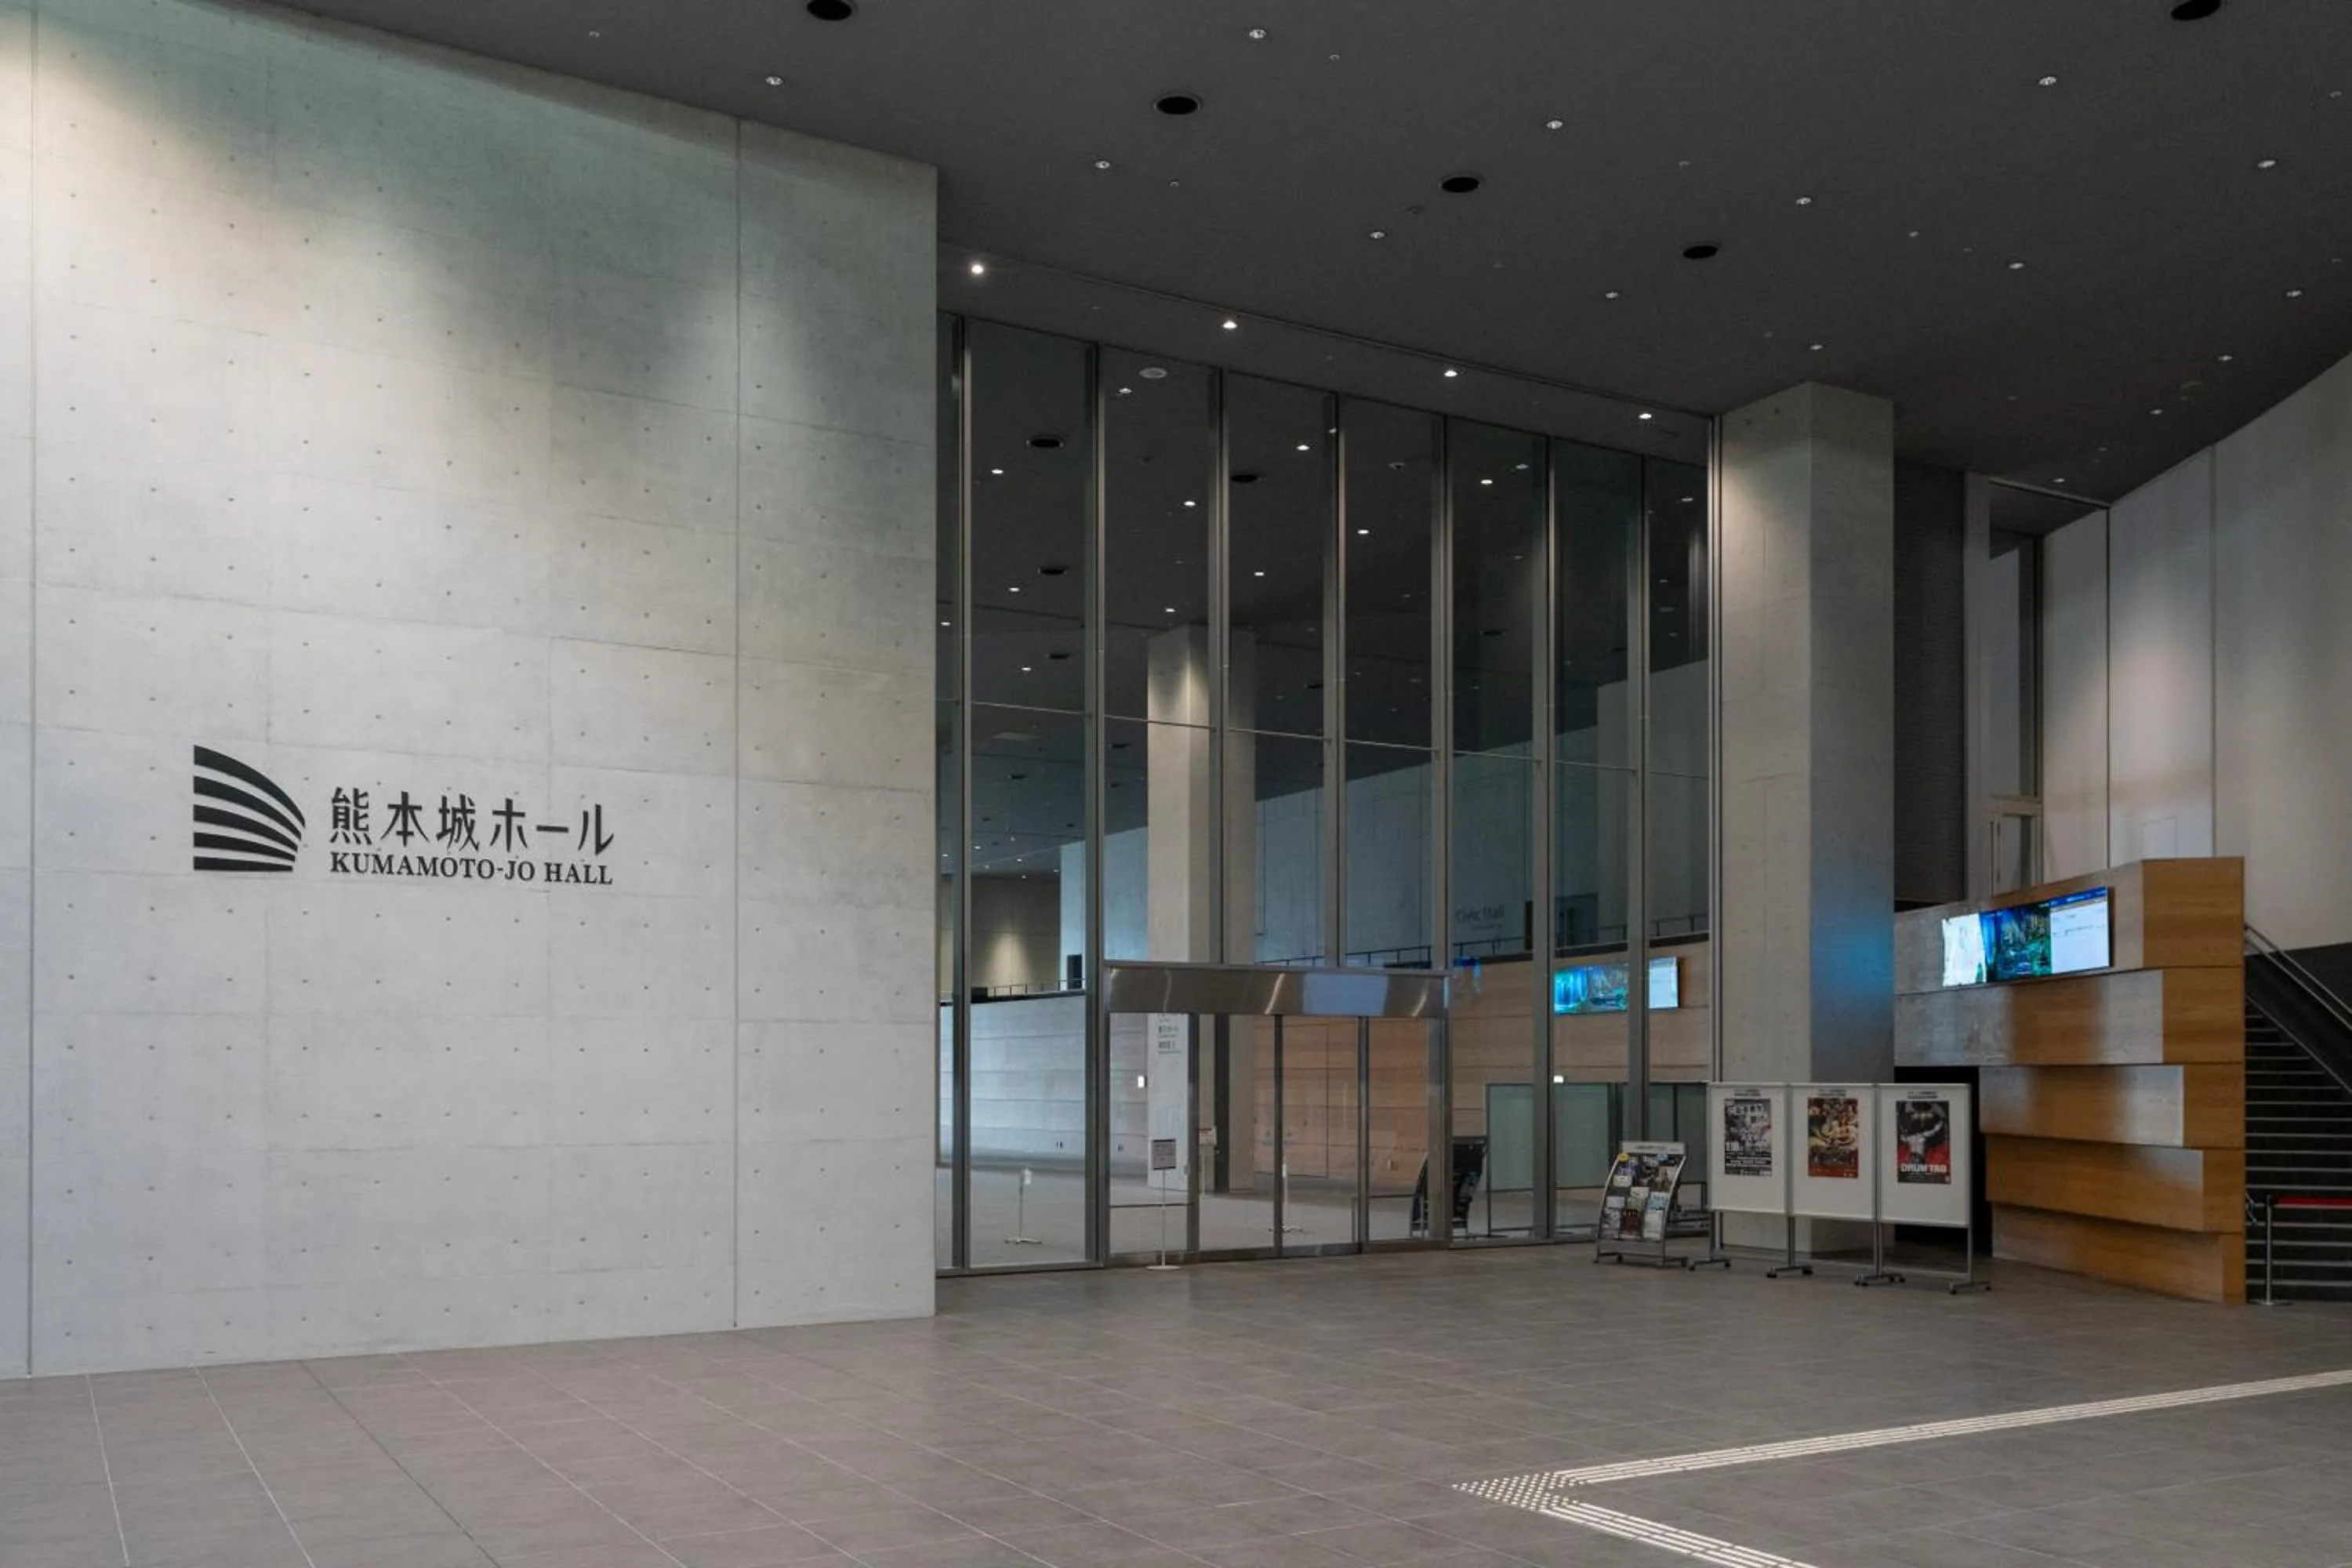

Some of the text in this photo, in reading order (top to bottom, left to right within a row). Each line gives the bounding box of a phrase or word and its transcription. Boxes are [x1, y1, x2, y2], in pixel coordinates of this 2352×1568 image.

[329, 786, 615, 855] 熊本城ホール
[330, 851, 614, 885] KUMAMOTO-JO HALL
